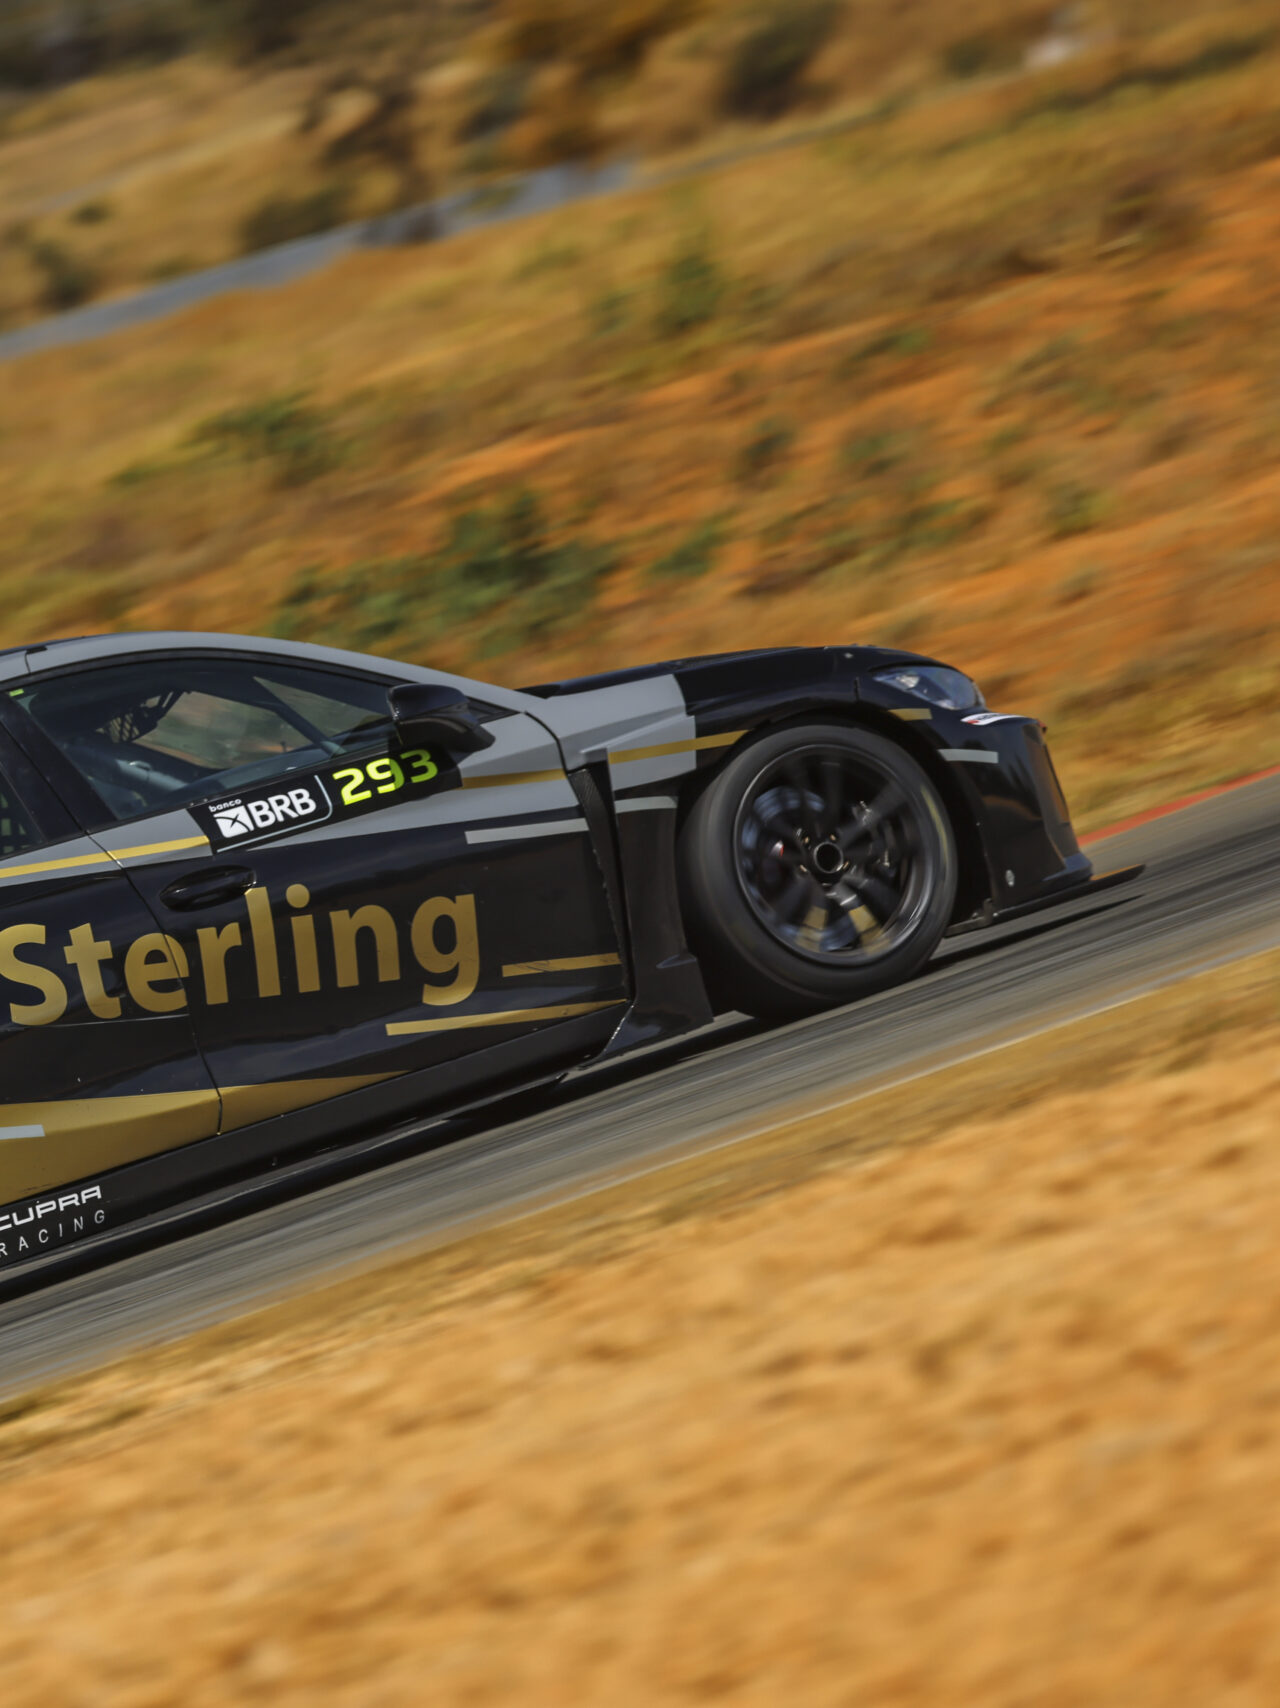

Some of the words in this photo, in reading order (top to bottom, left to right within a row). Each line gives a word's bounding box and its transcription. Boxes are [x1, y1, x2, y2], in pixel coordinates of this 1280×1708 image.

[332, 749, 439, 806] 293
[209, 798, 242, 813] banco
[247, 788, 317, 829] BRB
